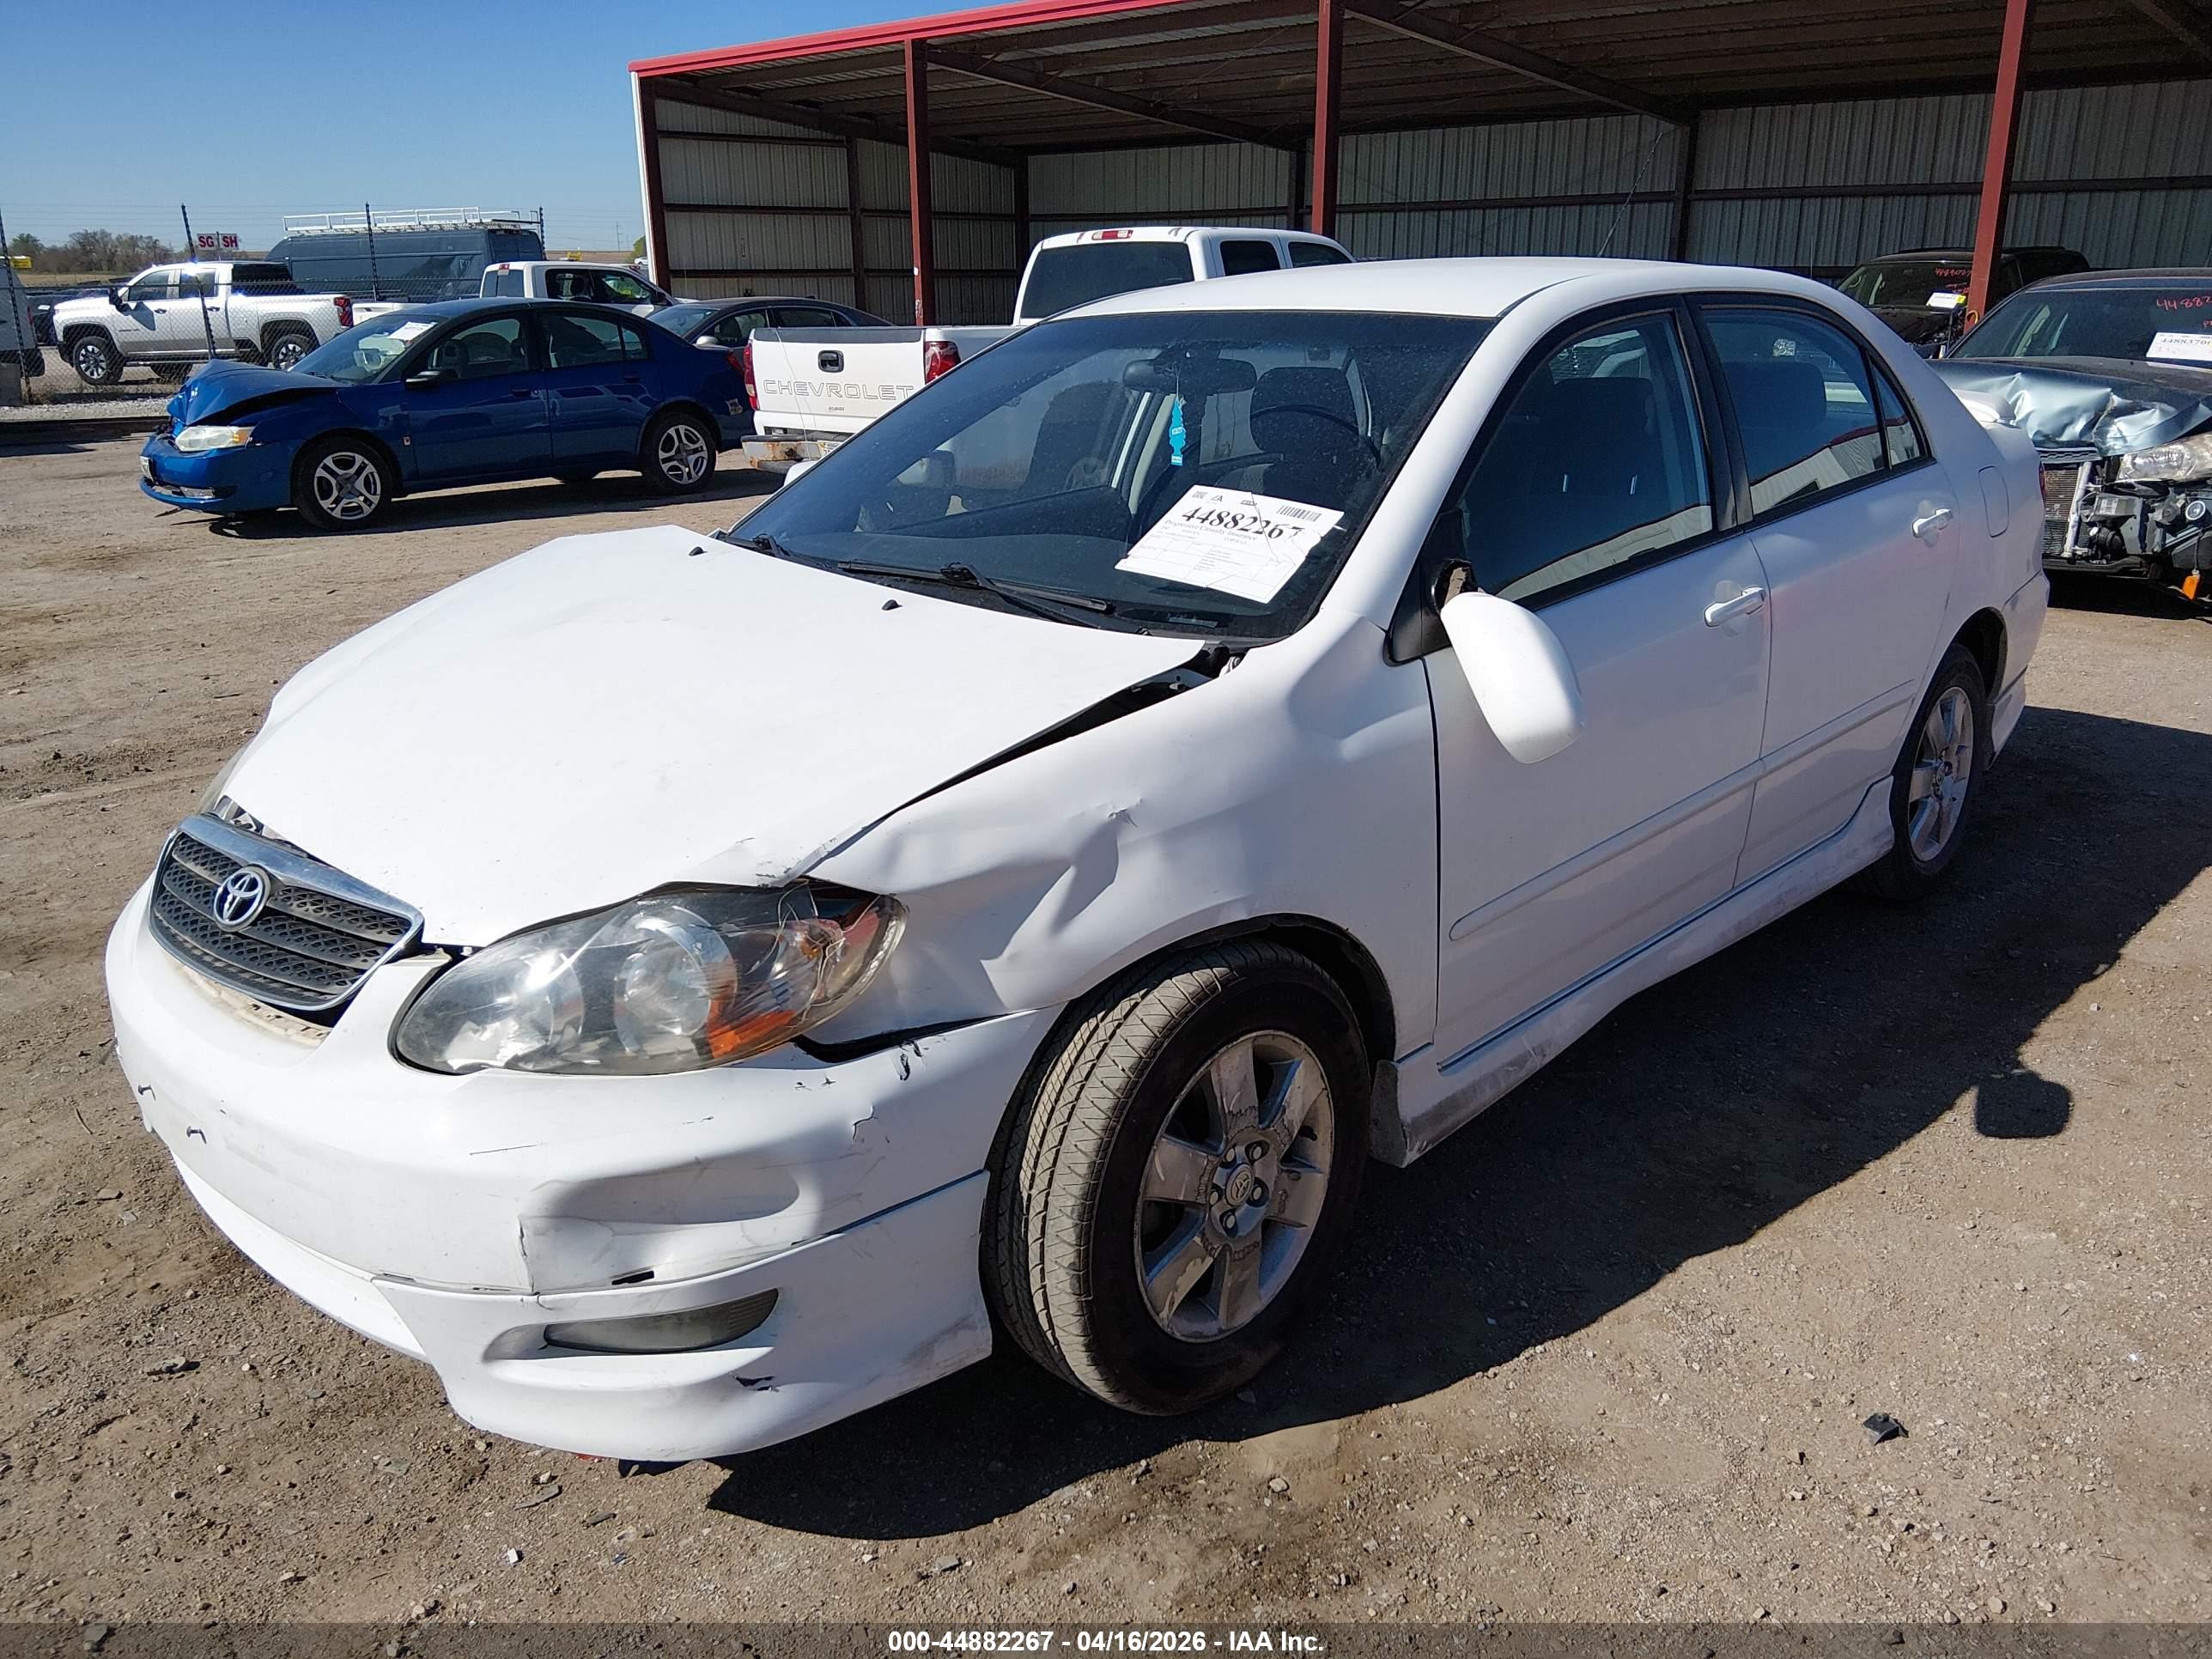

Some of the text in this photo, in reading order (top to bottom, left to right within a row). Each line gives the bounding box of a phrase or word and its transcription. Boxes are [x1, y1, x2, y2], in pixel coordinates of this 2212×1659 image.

[198, 235, 238, 247] SG SH
[763, 380, 914, 400] CHEVROLET
[1182, 507, 1306, 539] 44882267
